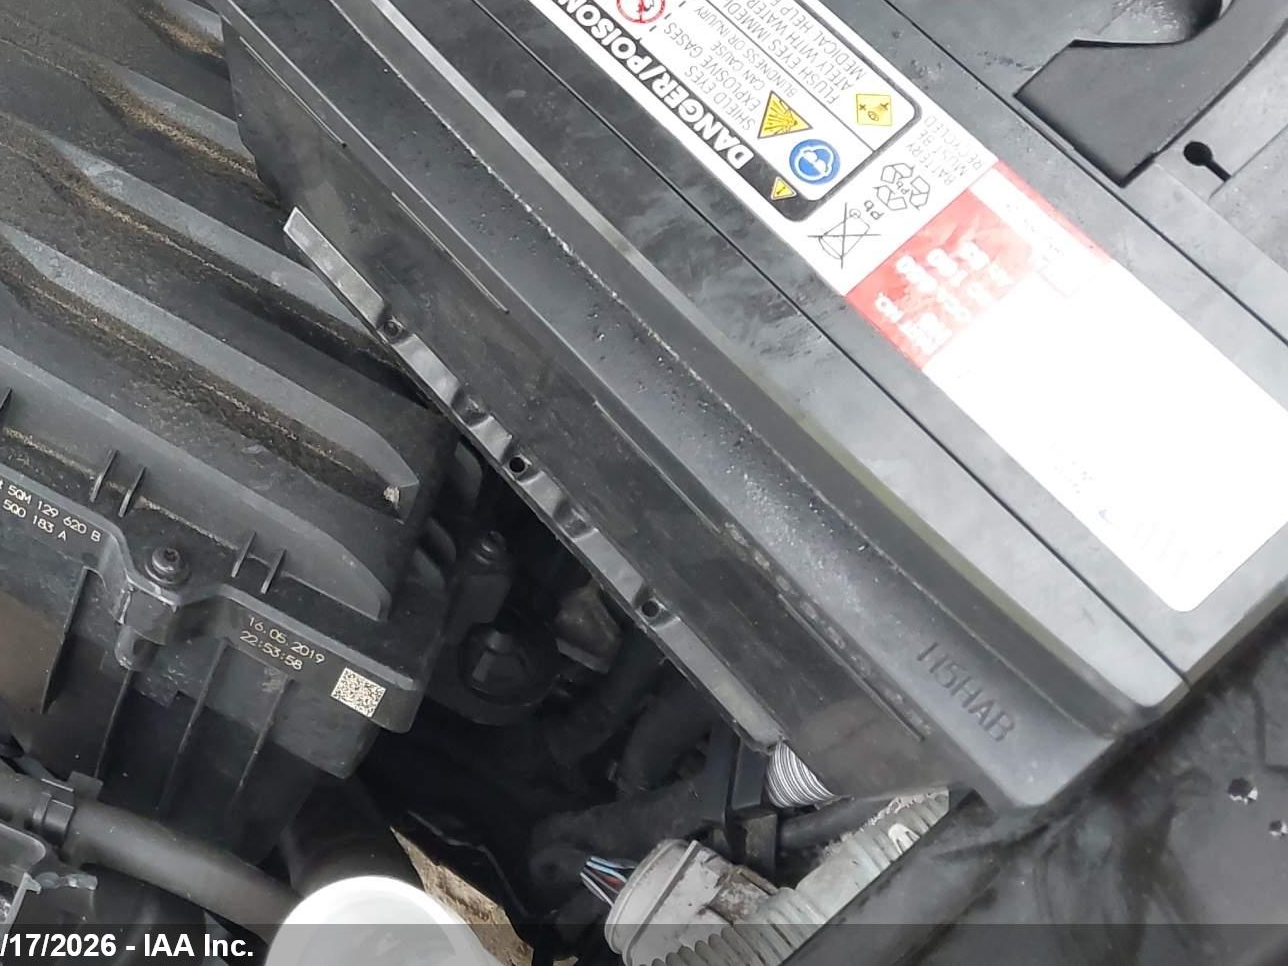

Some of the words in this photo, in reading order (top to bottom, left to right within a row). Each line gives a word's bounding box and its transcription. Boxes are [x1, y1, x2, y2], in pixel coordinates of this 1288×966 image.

[693, 5, 731, 37] INJURY
[779, 6, 814, 34] HELP
[663, 22, 704, 59] GASES
[710, 40, 745, 71] CAUSE
[727, 33, 746, 51] OR
[767, 38, 802, 70] EYES
[784, 31, 819, 64] WITH
[812, 30, 866, 82] MEDICAL
[684, 65, 717, 95] EYES
[699, 54, 762, 112] EXPLOSIVE
[742, 48, 795, 99] BLINDNESS
[742, 69, 765, 91] CAN
[797, 65, 840, 105] FLUSH
[815, 60, 854, 91] ATELY
[713, 92, 756, 131] SHIELD
[863, 199, 885, 221] Pb
[32, 514, 55, 533] 183
[57, 529, 67, 542] A
[37, 500, 59, 518] 129
[62, 516, 88, 534] 620
[90, 529, 101, 542] B
[239, 630, 303, 670] 22:53:58
[248, 617, 325, 664] 16.05.2019
